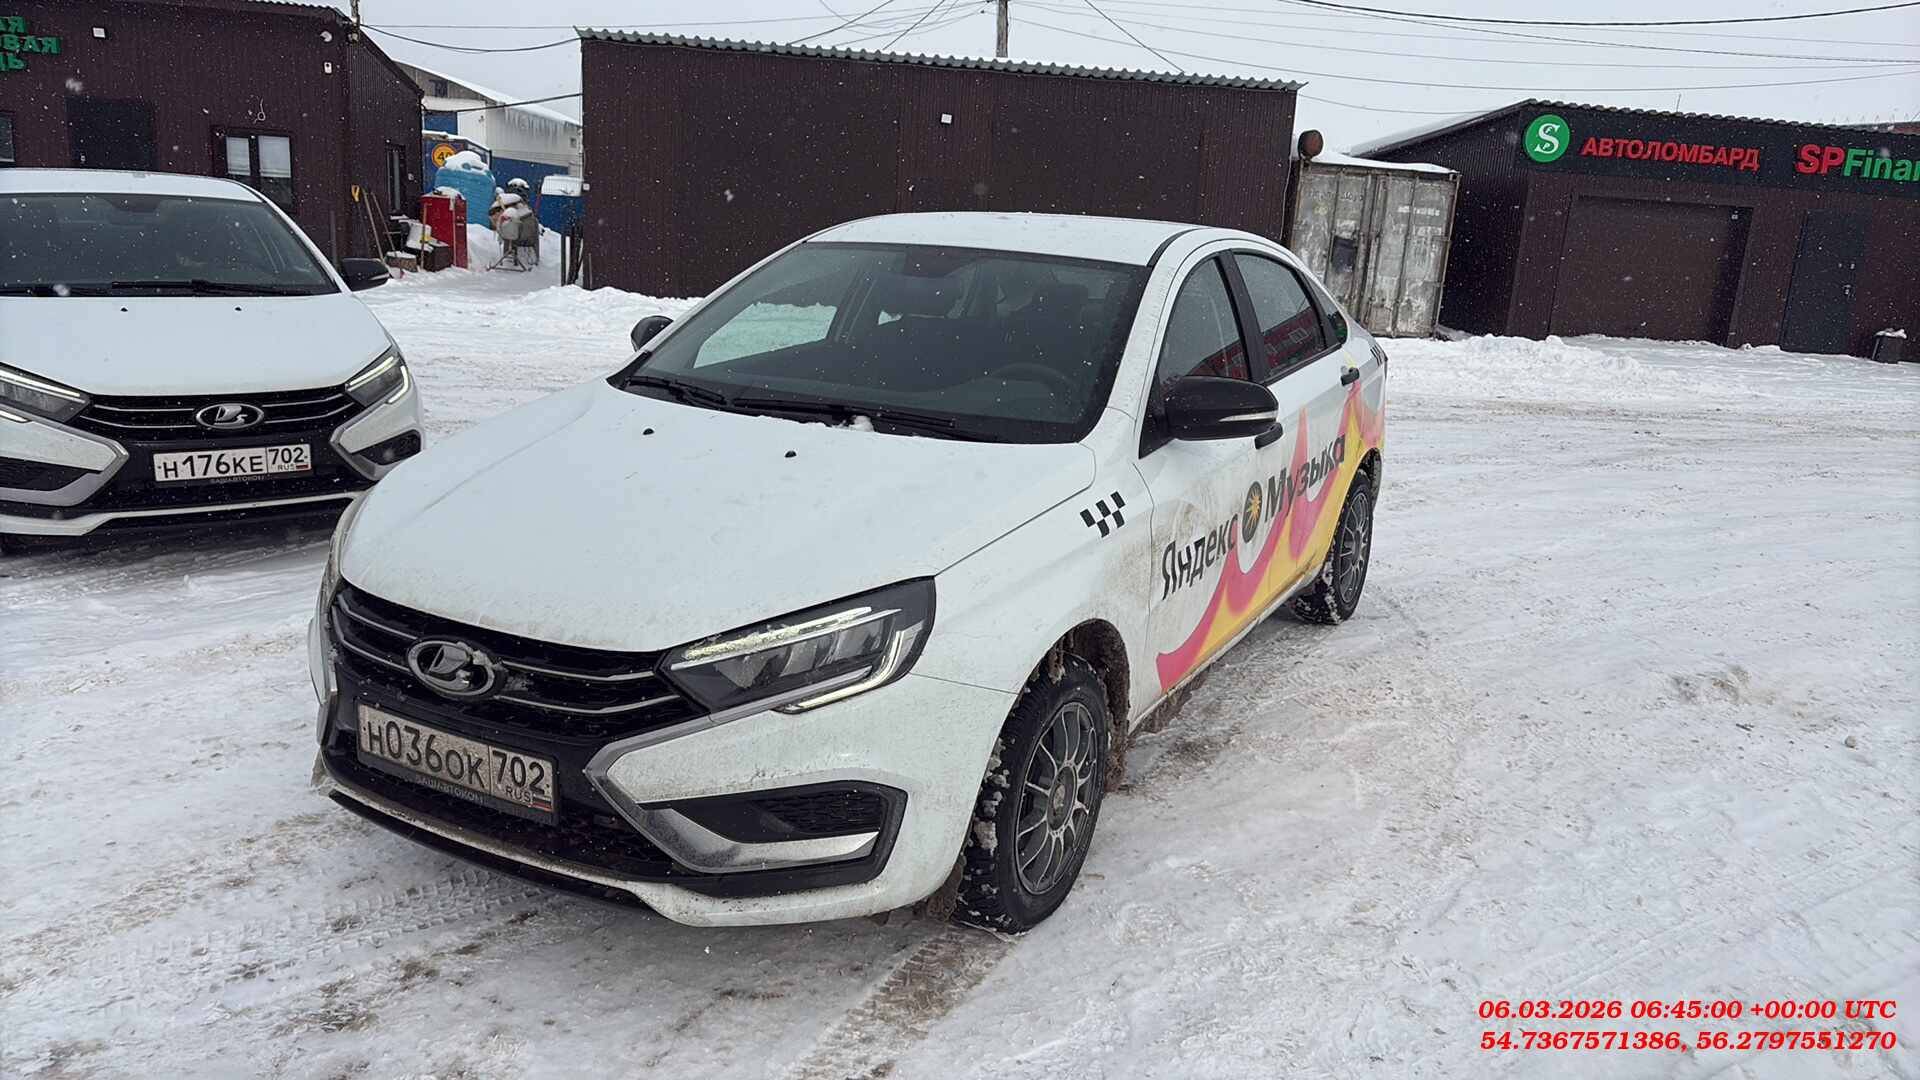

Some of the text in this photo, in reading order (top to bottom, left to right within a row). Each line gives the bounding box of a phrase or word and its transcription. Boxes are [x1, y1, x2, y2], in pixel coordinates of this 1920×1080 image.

[0, 34, 61, 55] ВАЯ
[1581, 136, 1760, 171] АВТОЛОМБАРД
[163, 454, 263, 479] Н176КЕ
[268, 447, 304, 465] 702
[1162, 434, 1346, 601] Яндекс Музыка
[367, 720, 546, 796] Н036ОК 702
[505, 785, 531, 803] RUS
